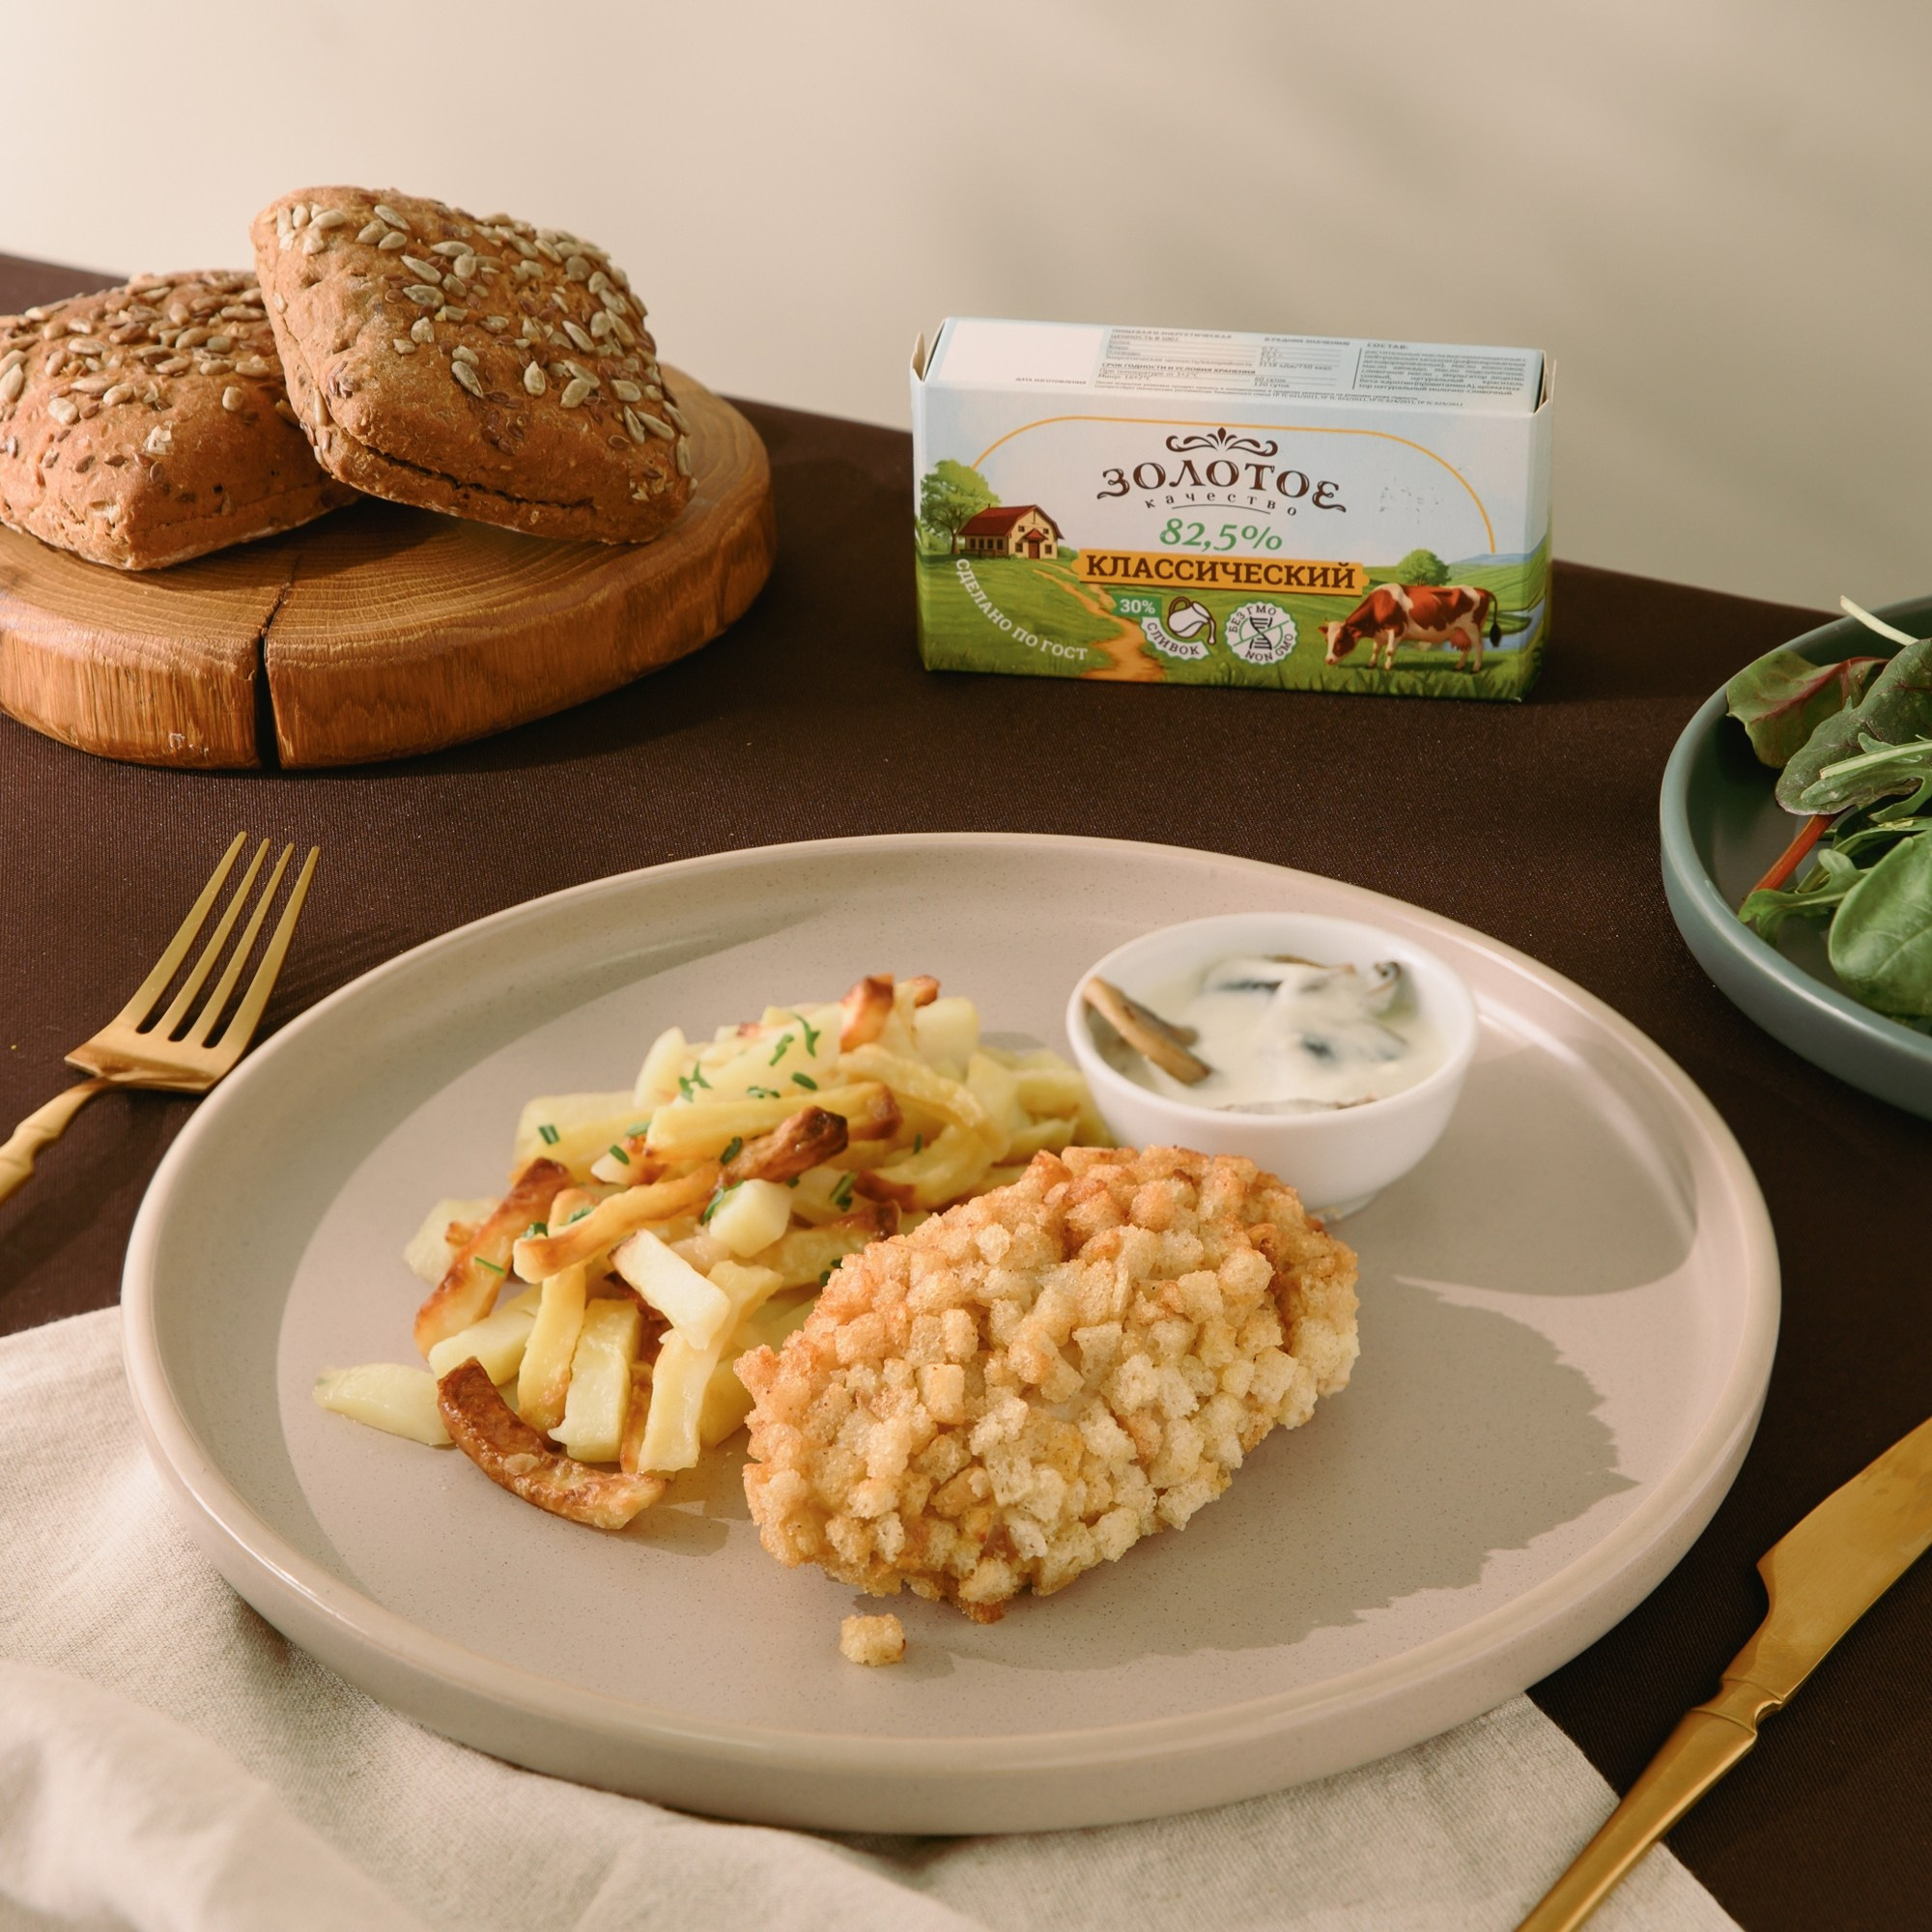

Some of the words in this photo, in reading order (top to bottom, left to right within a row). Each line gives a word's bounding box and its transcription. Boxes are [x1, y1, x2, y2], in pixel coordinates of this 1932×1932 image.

[1096, 460, 1346, 513] ЗОЛОТОЕ
[1145, 492, 1296, 516] качество
[1159, 518, 1283, 553] 82,5%
[1086, 554, 1356, 590] КЛАССИЧЕСКИЙ
[955, 558, 1012, 632] СДЕЛАНО
[1011, 626, 1039, 647] ПО
[1039, 639, 1089, 661] ГОСТ
[1120, 598, 1156, 614] 30%
[1229, 611, 1245, 634] БЕЗ
[1246, 604, 1277, 616] ГМО
[1147, 621, 1201, 657] СЛИВОК
[1245, 649, 1273, 662] NON
[1275, 633, 1294, 657] GMO
